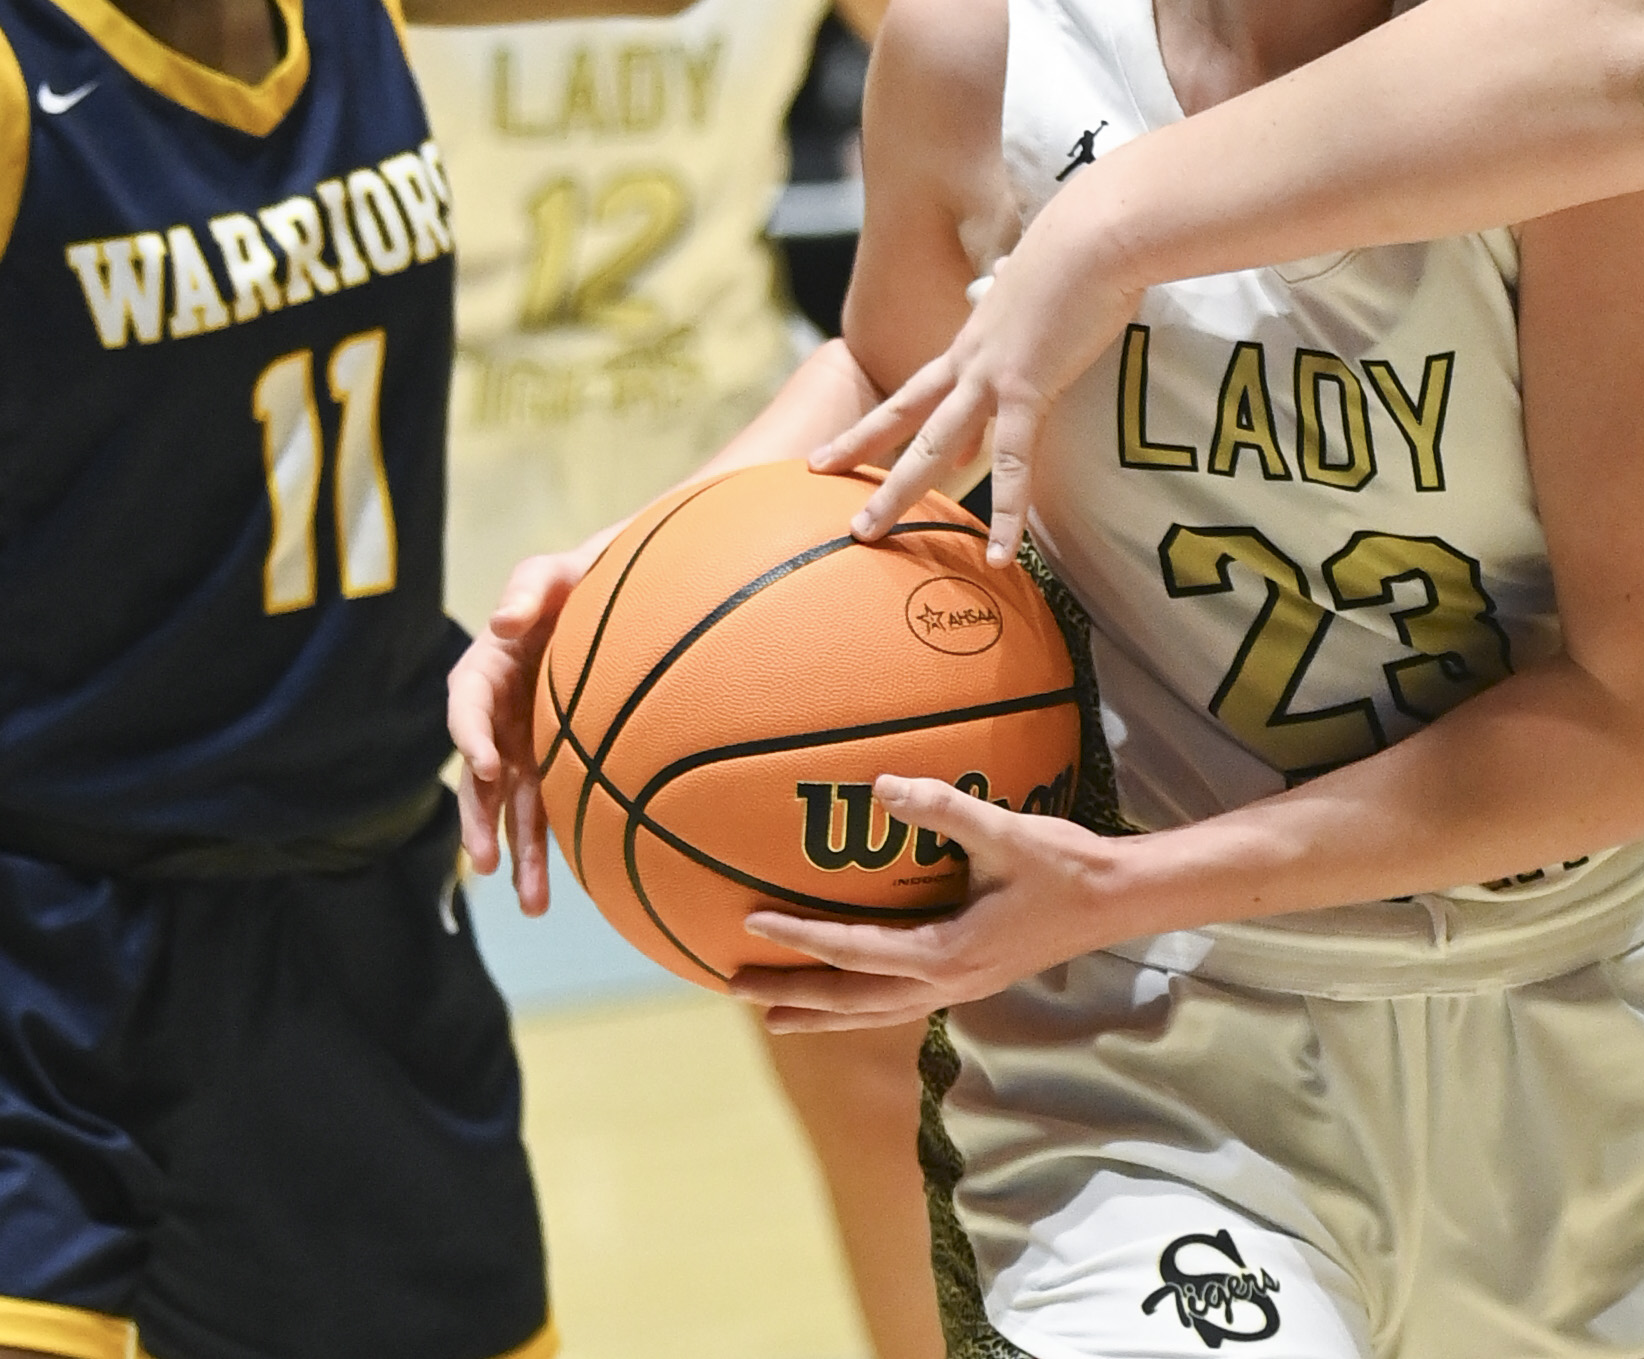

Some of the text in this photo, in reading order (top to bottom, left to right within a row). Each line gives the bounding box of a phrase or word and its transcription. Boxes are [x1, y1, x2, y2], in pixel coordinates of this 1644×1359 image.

[492, 33, 724, 137] LADY
[519, 168, 694, 333] 12
[252, 325, 398, 616] 11
[1117, 323, 1456, 492] LADY
[948, 607, 998, 628] AHSAA
[1157, 523, 1515, 790] 23
[1141, 1266, 1281, 1329] Tigers
